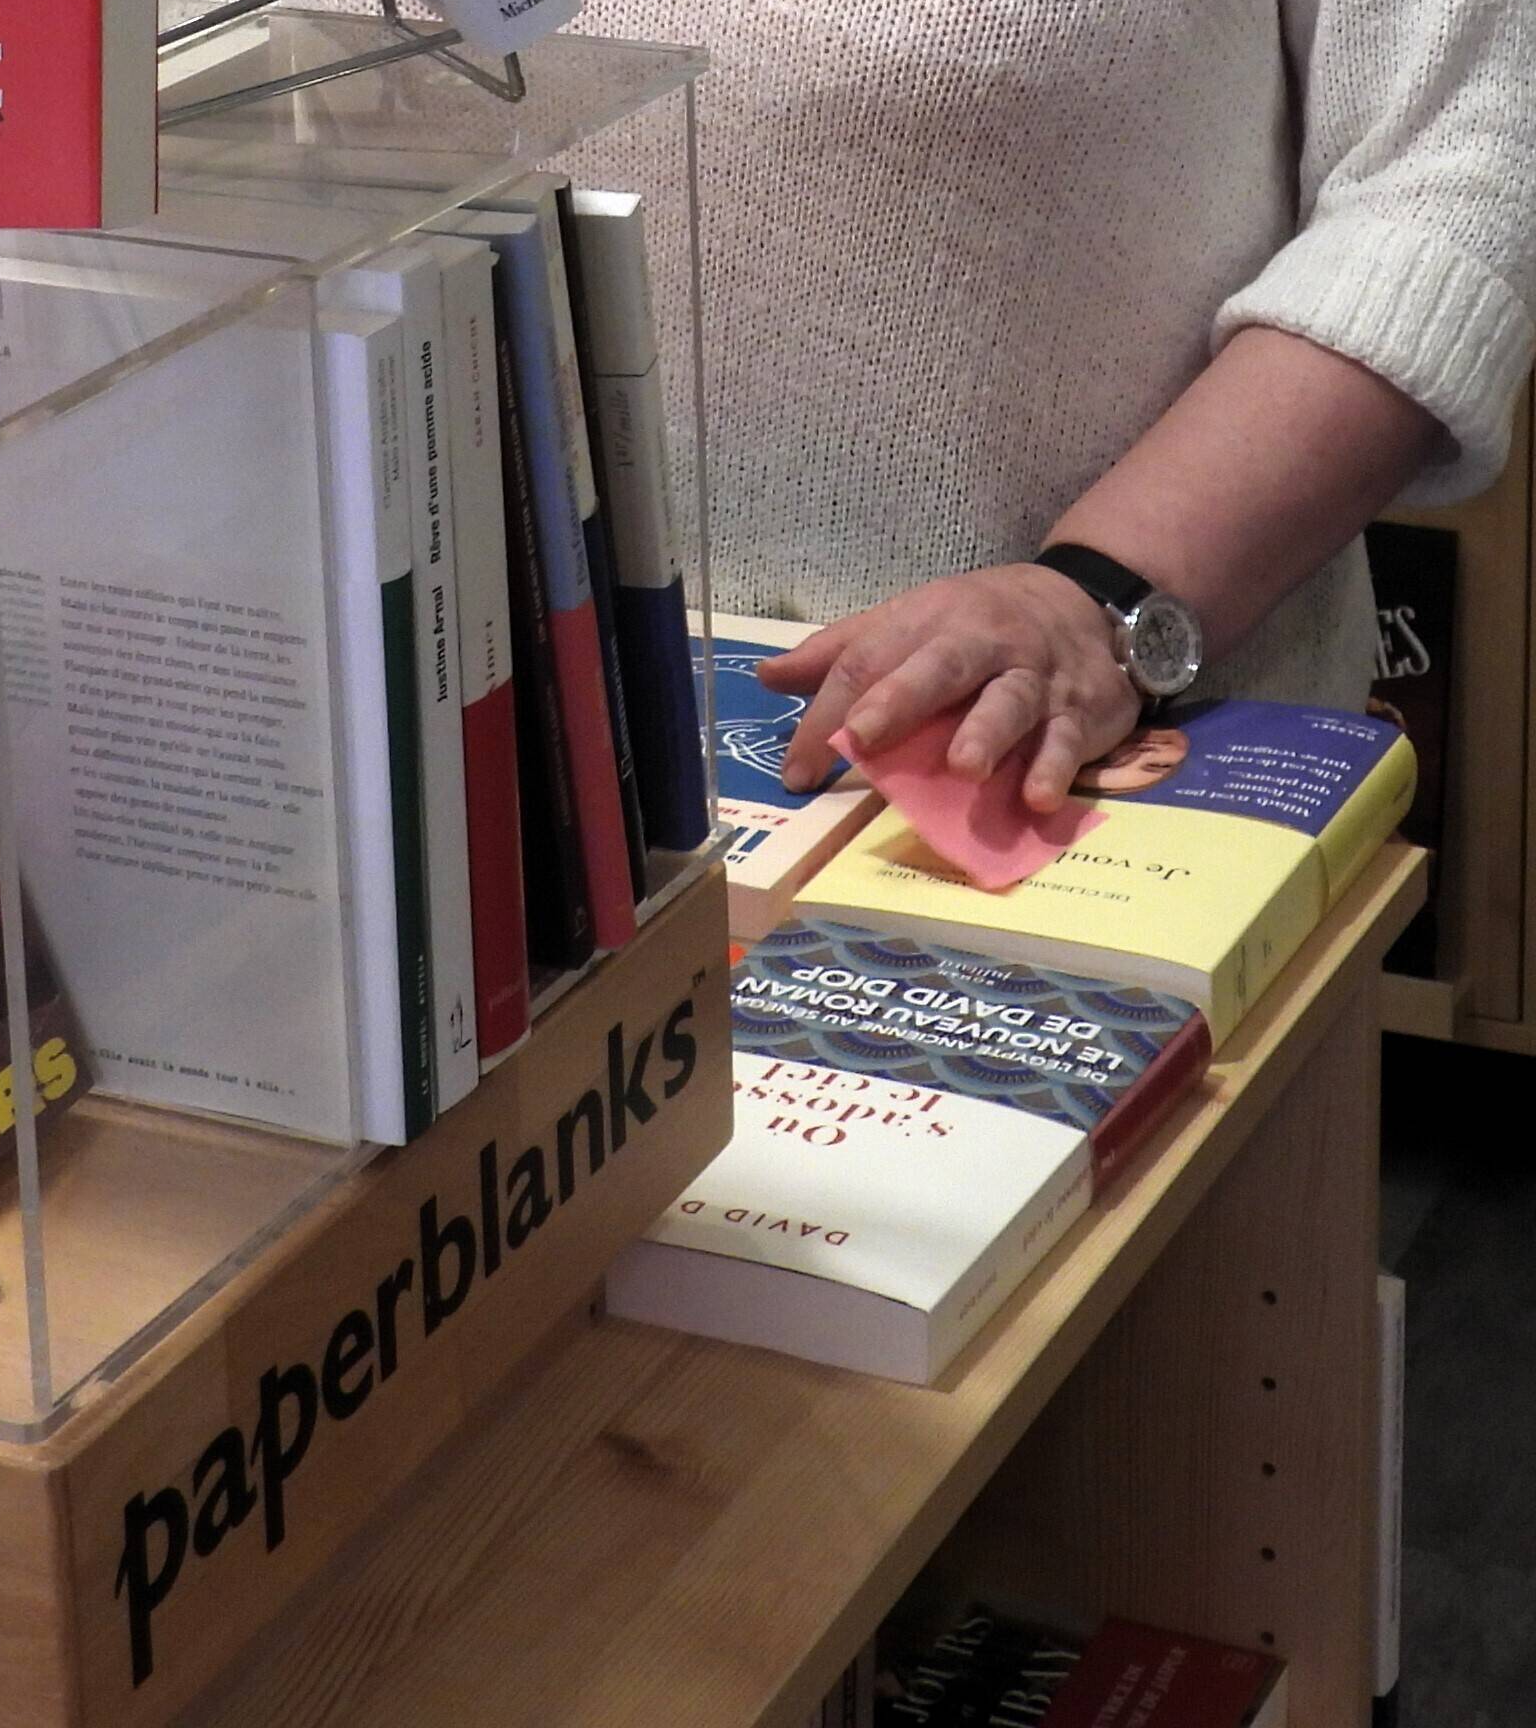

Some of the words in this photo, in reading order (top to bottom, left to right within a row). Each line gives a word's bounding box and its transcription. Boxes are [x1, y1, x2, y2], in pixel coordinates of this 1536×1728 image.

[468, 314, 481, 384] CHICHE
[418, 340, 434, 389] acide
[422, 394, 439, 461] pomme
[472, 390, 484, 448] SARAH
[425, 464, 440, 515] d'une
[426, 519, 443, 564] Rêve
[430, 584, 446, 634] Arnal
[432, 637, 449, 703] Justine
[1203, 753, 1253, 768] celles
[1257, 758, 1280, 772] de
[1321, 756, 1352, 773] qui
[1223, 781, 1286, 798] femme
[1302, 781, 1332, 796] qui
[1309, 767, 1344, 784] Elle
[1174, 786, 1206, 800] pas
[1208, 789, 1251, 806] n'est
[1255, 794, 1312, 819] Milady
[1290, 793, 1322, 808] une
[1144, 861, 1192, 882] Je
[790, 963, 897, 996] DIOP
[736, 974, 879, 1015] ROMAN
[902, 984, 1036, 1029] DAVID
[821, 1012, 856, 1029] AU
[858, 1018, 972, 1051] ANCIENNE
[881, 999, 1071, 1057] NOUVEAU
[1039, 1013, 1103, 1040] DE
[1081, 1044, 1124, 1071] LE
[760, 1062, 870, 1092] ciel
[1076, 1066, 1108, 1084] DE
[889, 1086, 943, 1112] le
[766, 1115, 847, 1146] Où
[723, 1205, 850, 1247] DAVID
